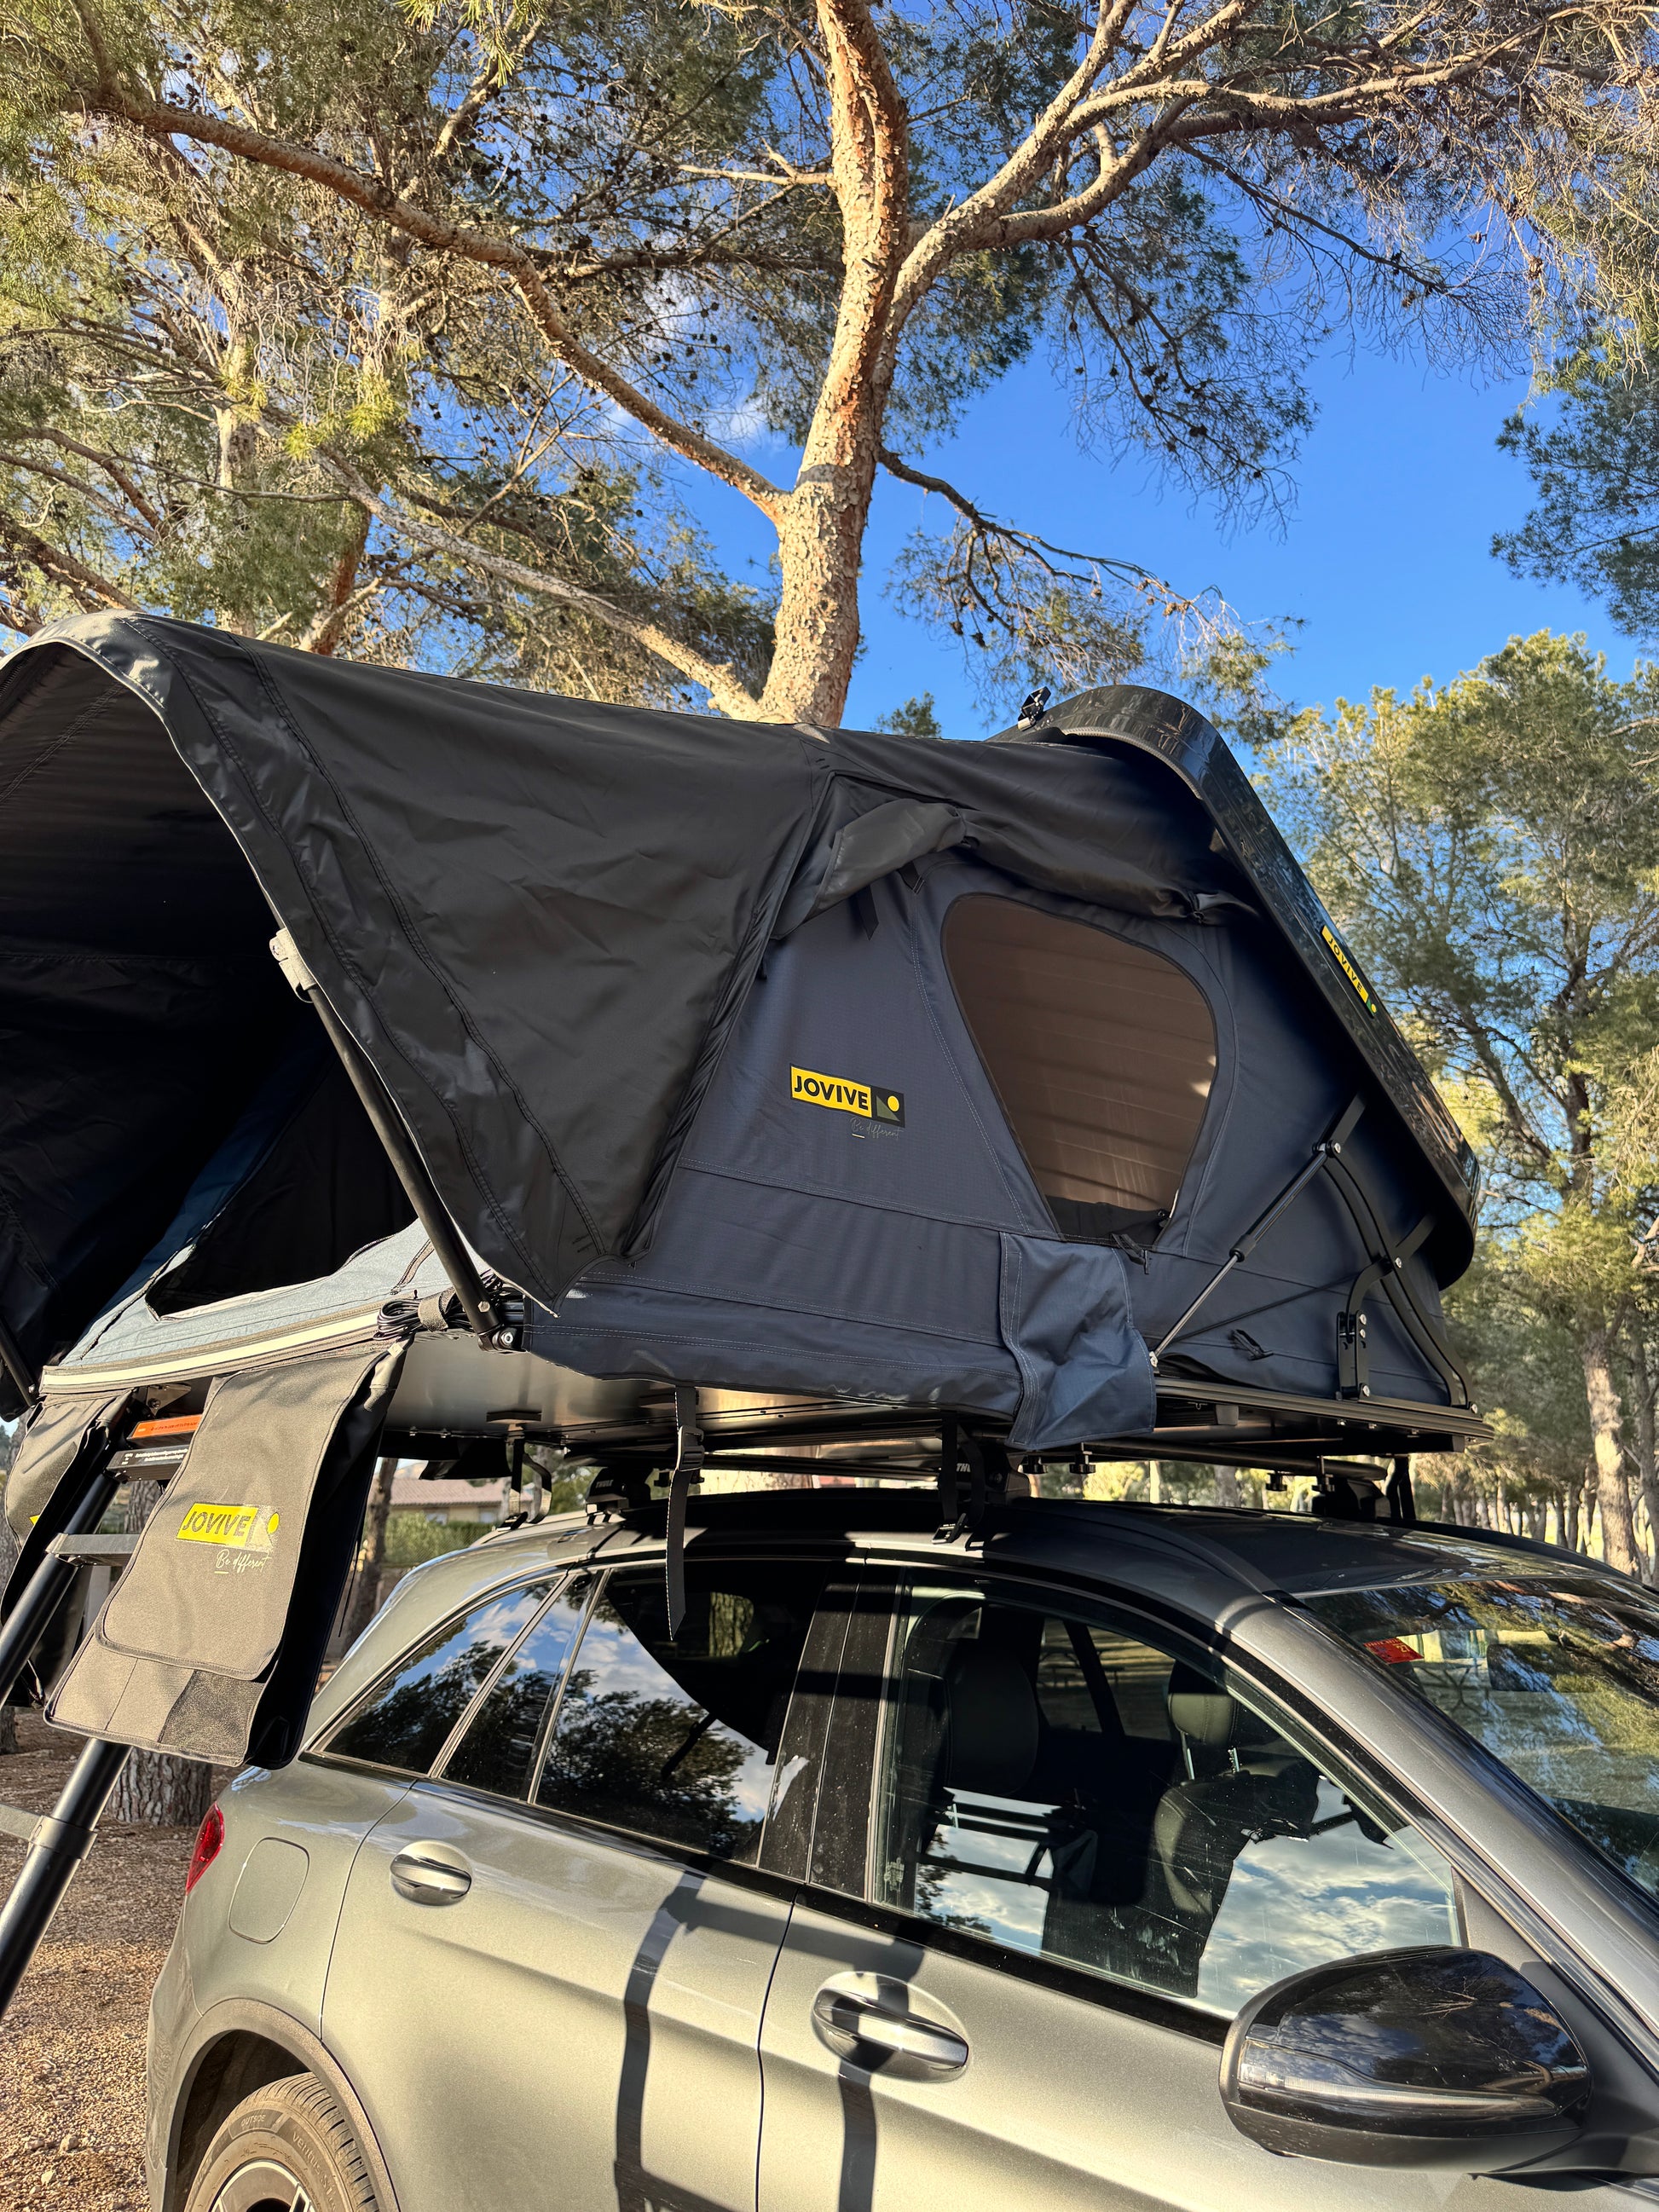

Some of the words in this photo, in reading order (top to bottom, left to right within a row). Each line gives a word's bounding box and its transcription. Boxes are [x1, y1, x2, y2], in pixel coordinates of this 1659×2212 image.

[1328, 939, 1362, 993] JOVIVE
[794, 1075, 869, 1111] JOVIVE
[850, 1117, 864, 1132] Be
[865, 1121, 904, 1141] different
[182, 1510, 251, 1537] JOVIVE
[216, 1549, 231, 1568] Be
[233, 1552, 272, 1574] different
